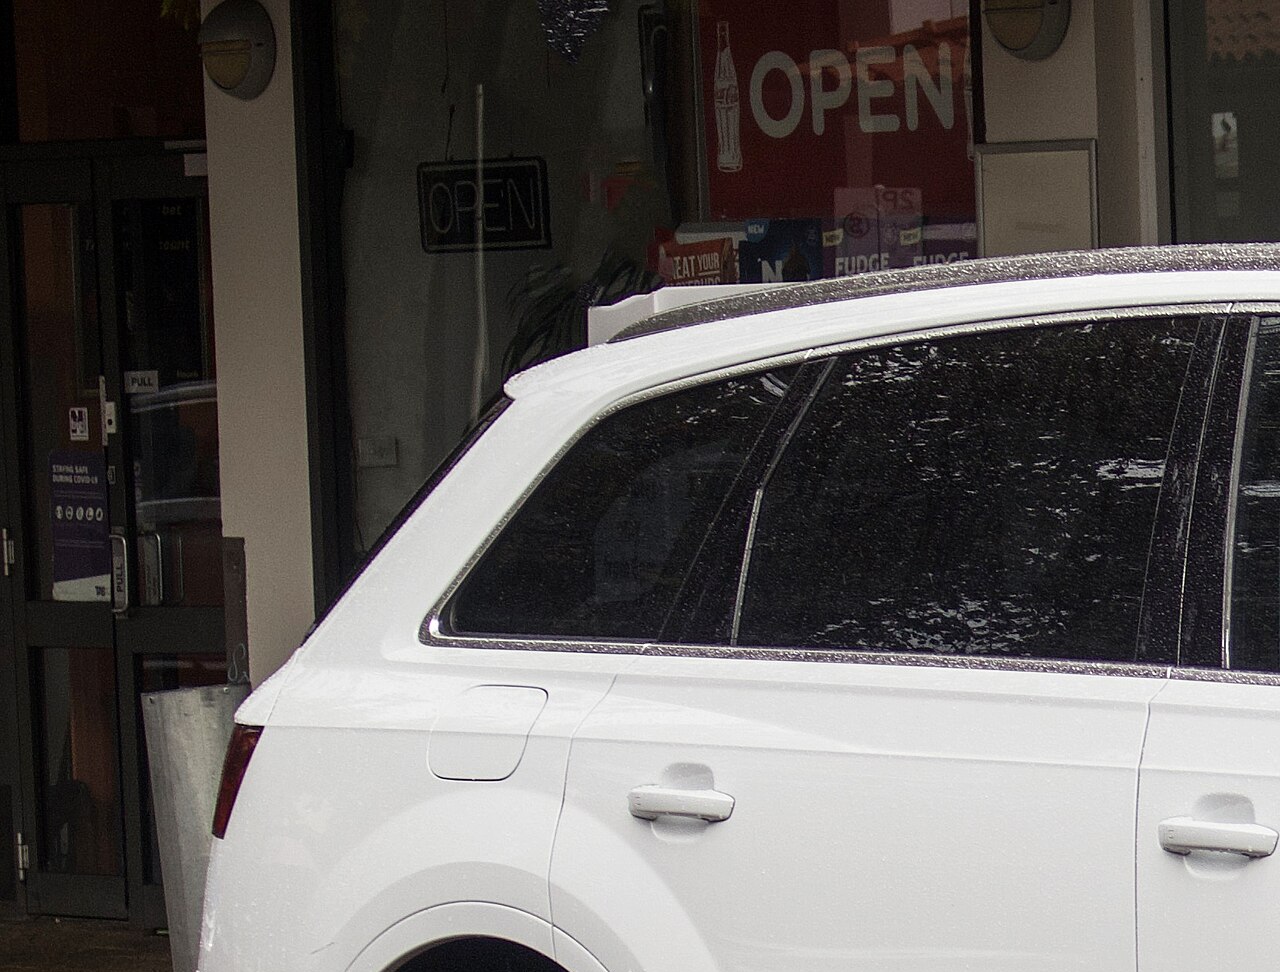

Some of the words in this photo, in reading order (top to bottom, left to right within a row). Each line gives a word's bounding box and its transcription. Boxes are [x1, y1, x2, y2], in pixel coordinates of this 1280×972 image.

[749, 42, 955, 139] OPEN
[429, 177, 536, 234] OPEN
[697, 252, 720, 271] YOUR
[835, 253, 890, 278] FUDGE
[131, 377, 154, 387] PULL
[116, 564, 124, 593] PULL
